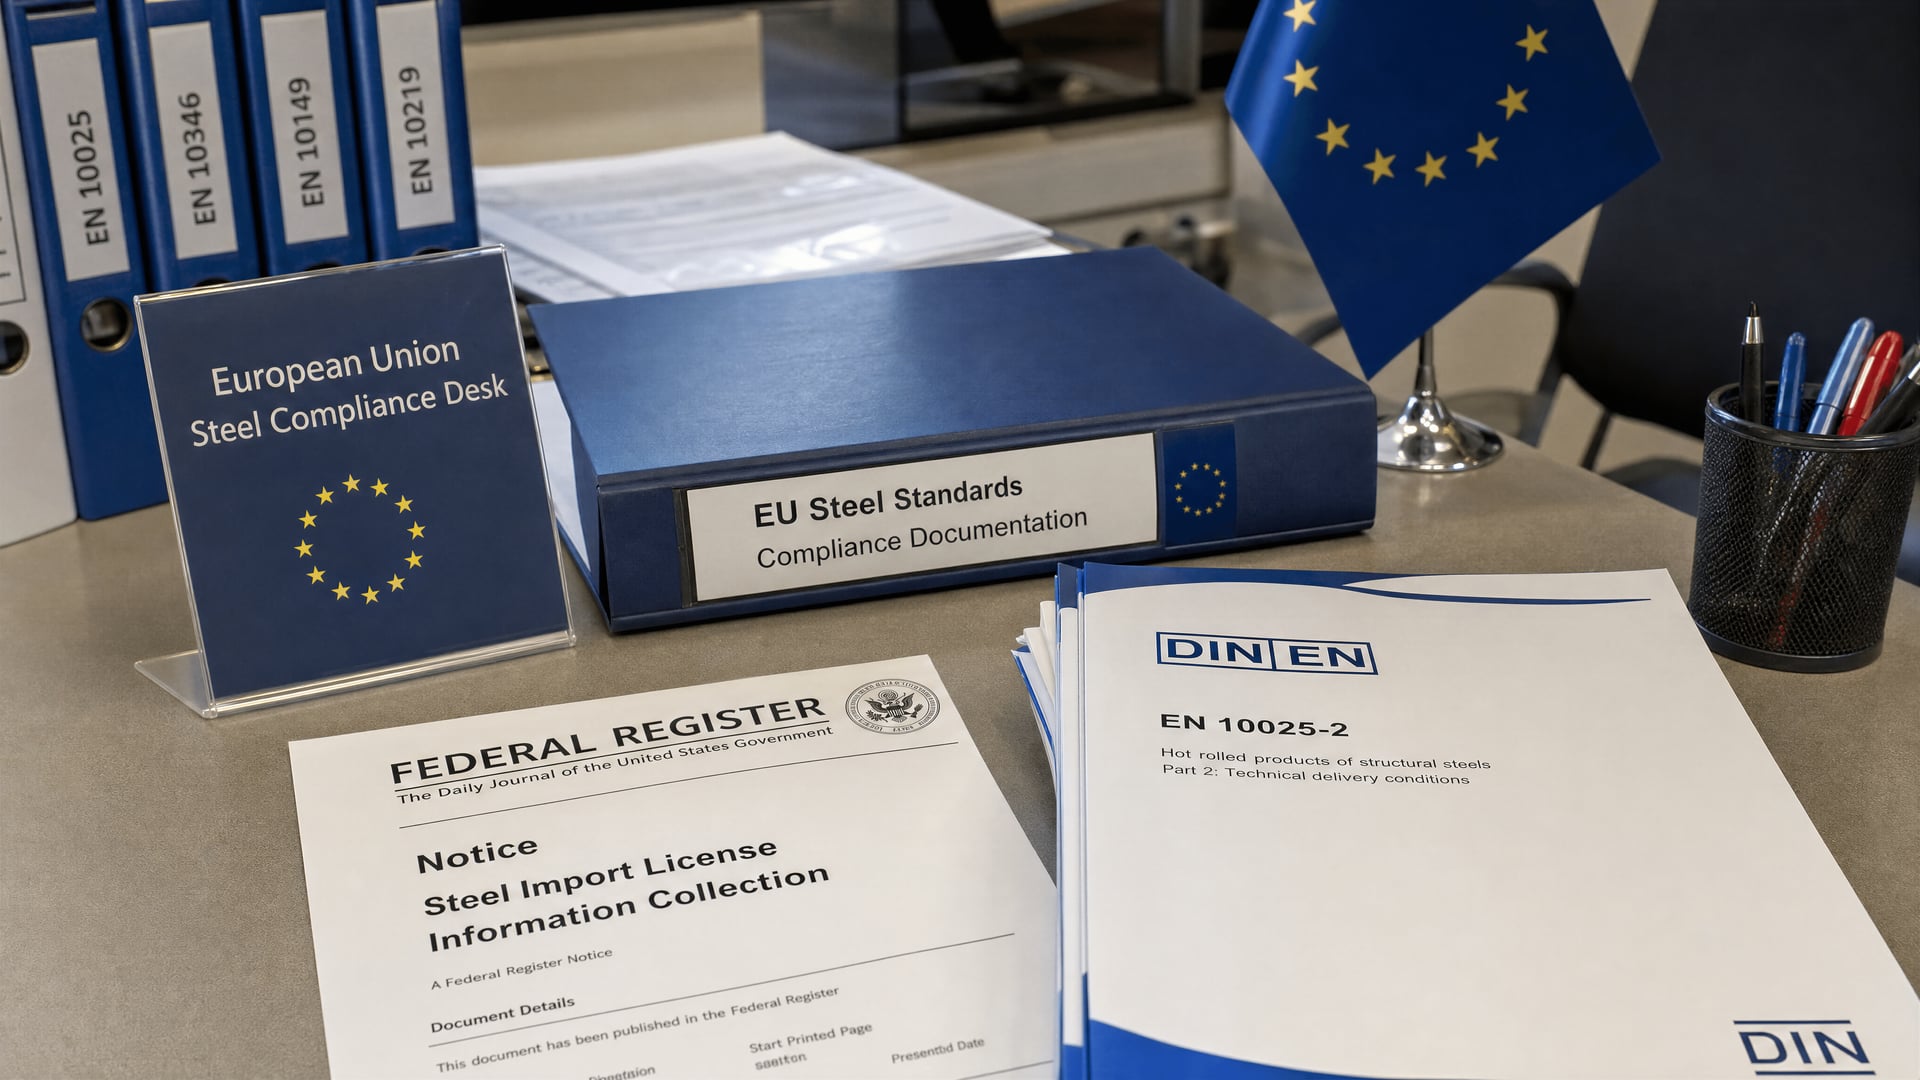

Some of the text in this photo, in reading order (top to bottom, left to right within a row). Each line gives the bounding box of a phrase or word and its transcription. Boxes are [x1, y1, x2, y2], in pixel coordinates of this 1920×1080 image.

[289, 78, 324, 207] EN 10149
[399, 67, 432, 194] EN 10219
[68, 111, 110, 246] EN 10025
[178, 93, 216, 225] EN 10346
[212, 340, 459, 396] European Union
[191, 374, 508, 446] Steel Compliance Desk
[755, 476, 1022, 527] EU Steel Standards
[758, 509, 1088, 568] Compliance Documentation
[1167, 638, 1366, 668] DIN EN
[390, 734, 597, 784] FEDERAL
[612, 697, 826, 747] REGISTER
[1160, 713, 1349, 737] EN 10025-2
[397, 726, 834, 804] The Daily Journal of the United States Government
[1161, 747, 1491, 769] Hot rolled products of structural steels
[1163, 763, 1470, 785] Part 2: Technical delivery conditions
[417, 839, 538, 874] Notice
[425, 842, 778, 915] Steel Import License
[429, 865, 829, 952] Information Collection
[431, 949, 613, 990] A Federal Register Notice
[430, 997, 576, 1034] Document Details
[436, 987, 839, 1073] This document has been published in the Federal Register
[749, 1024, 873, 1054] Start Printed Page
[956, 1038, 985, 1051] Date
[1739, 1031, 1869, 1064] DIN
